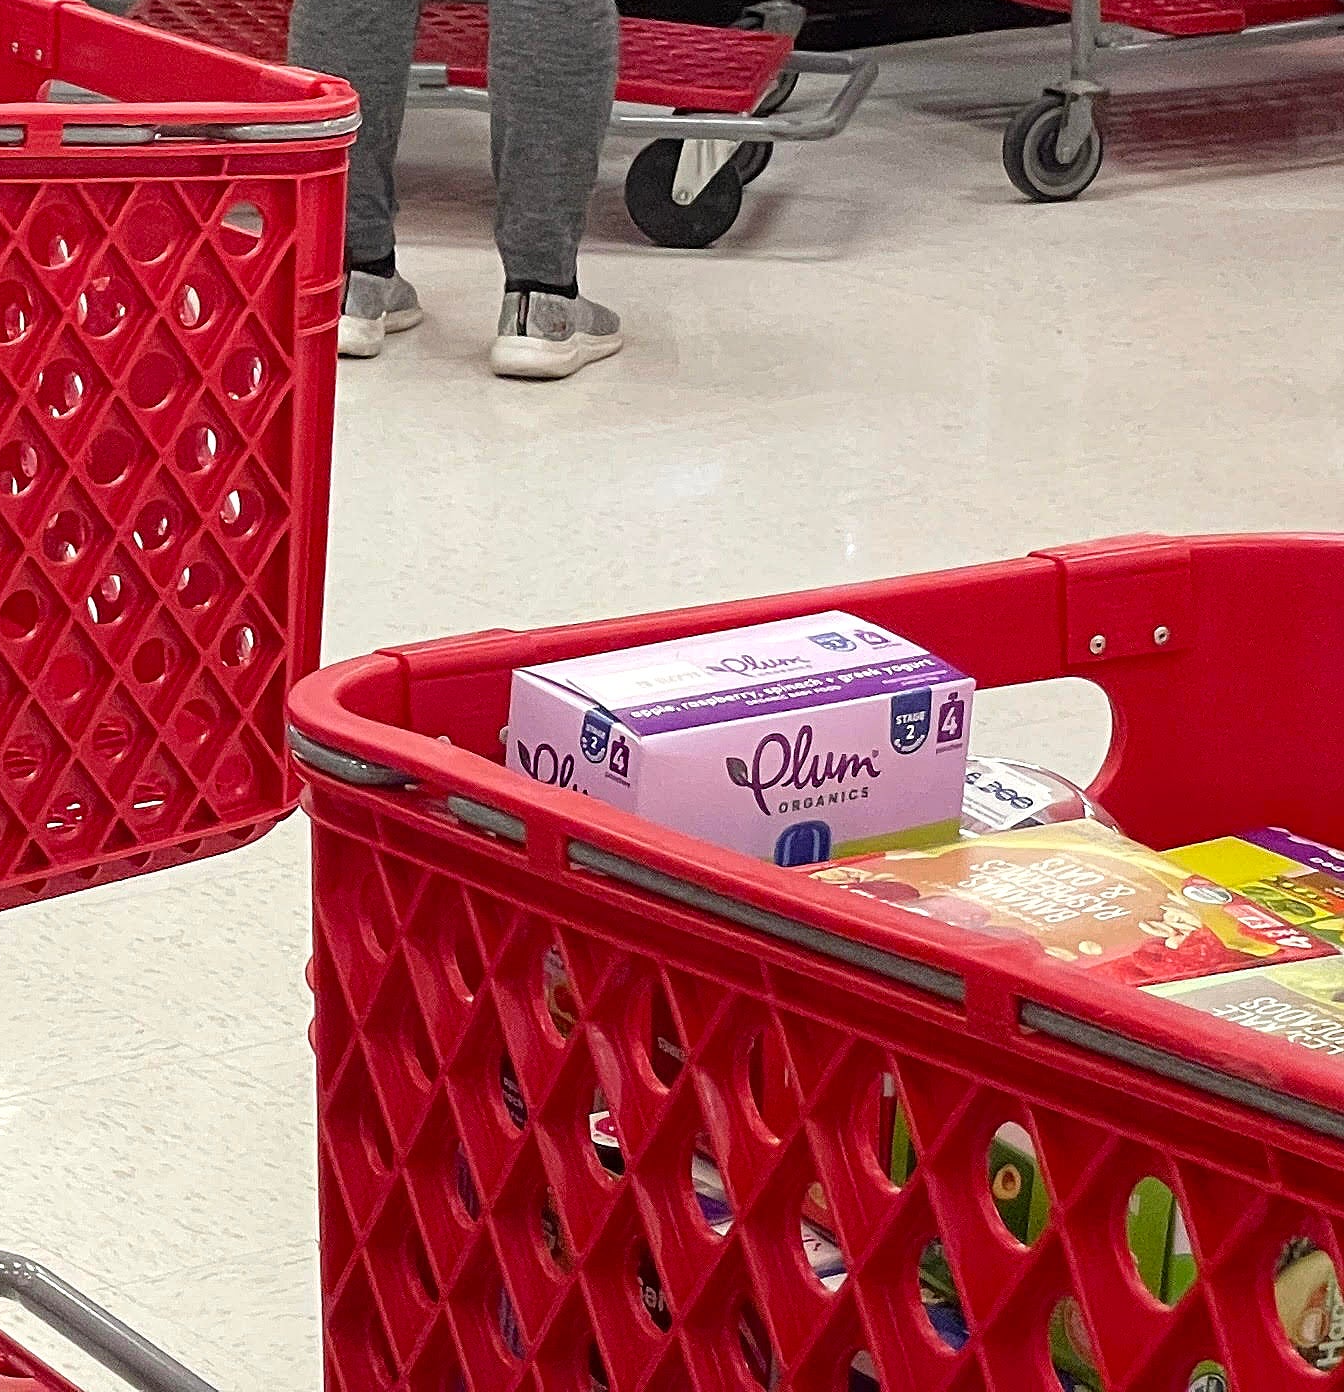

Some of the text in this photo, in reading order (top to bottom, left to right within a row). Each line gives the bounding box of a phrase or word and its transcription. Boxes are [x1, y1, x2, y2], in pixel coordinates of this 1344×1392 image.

[895, 710, 926, 725] STAGE
[941, 706, 958, 735] 4
[905, 724, 915, 740] 2
[746, 724, 881, 816] Plum
[778, 786, 870, 814] ORGANICS
[1029, 857, 1105, 887] OATS
